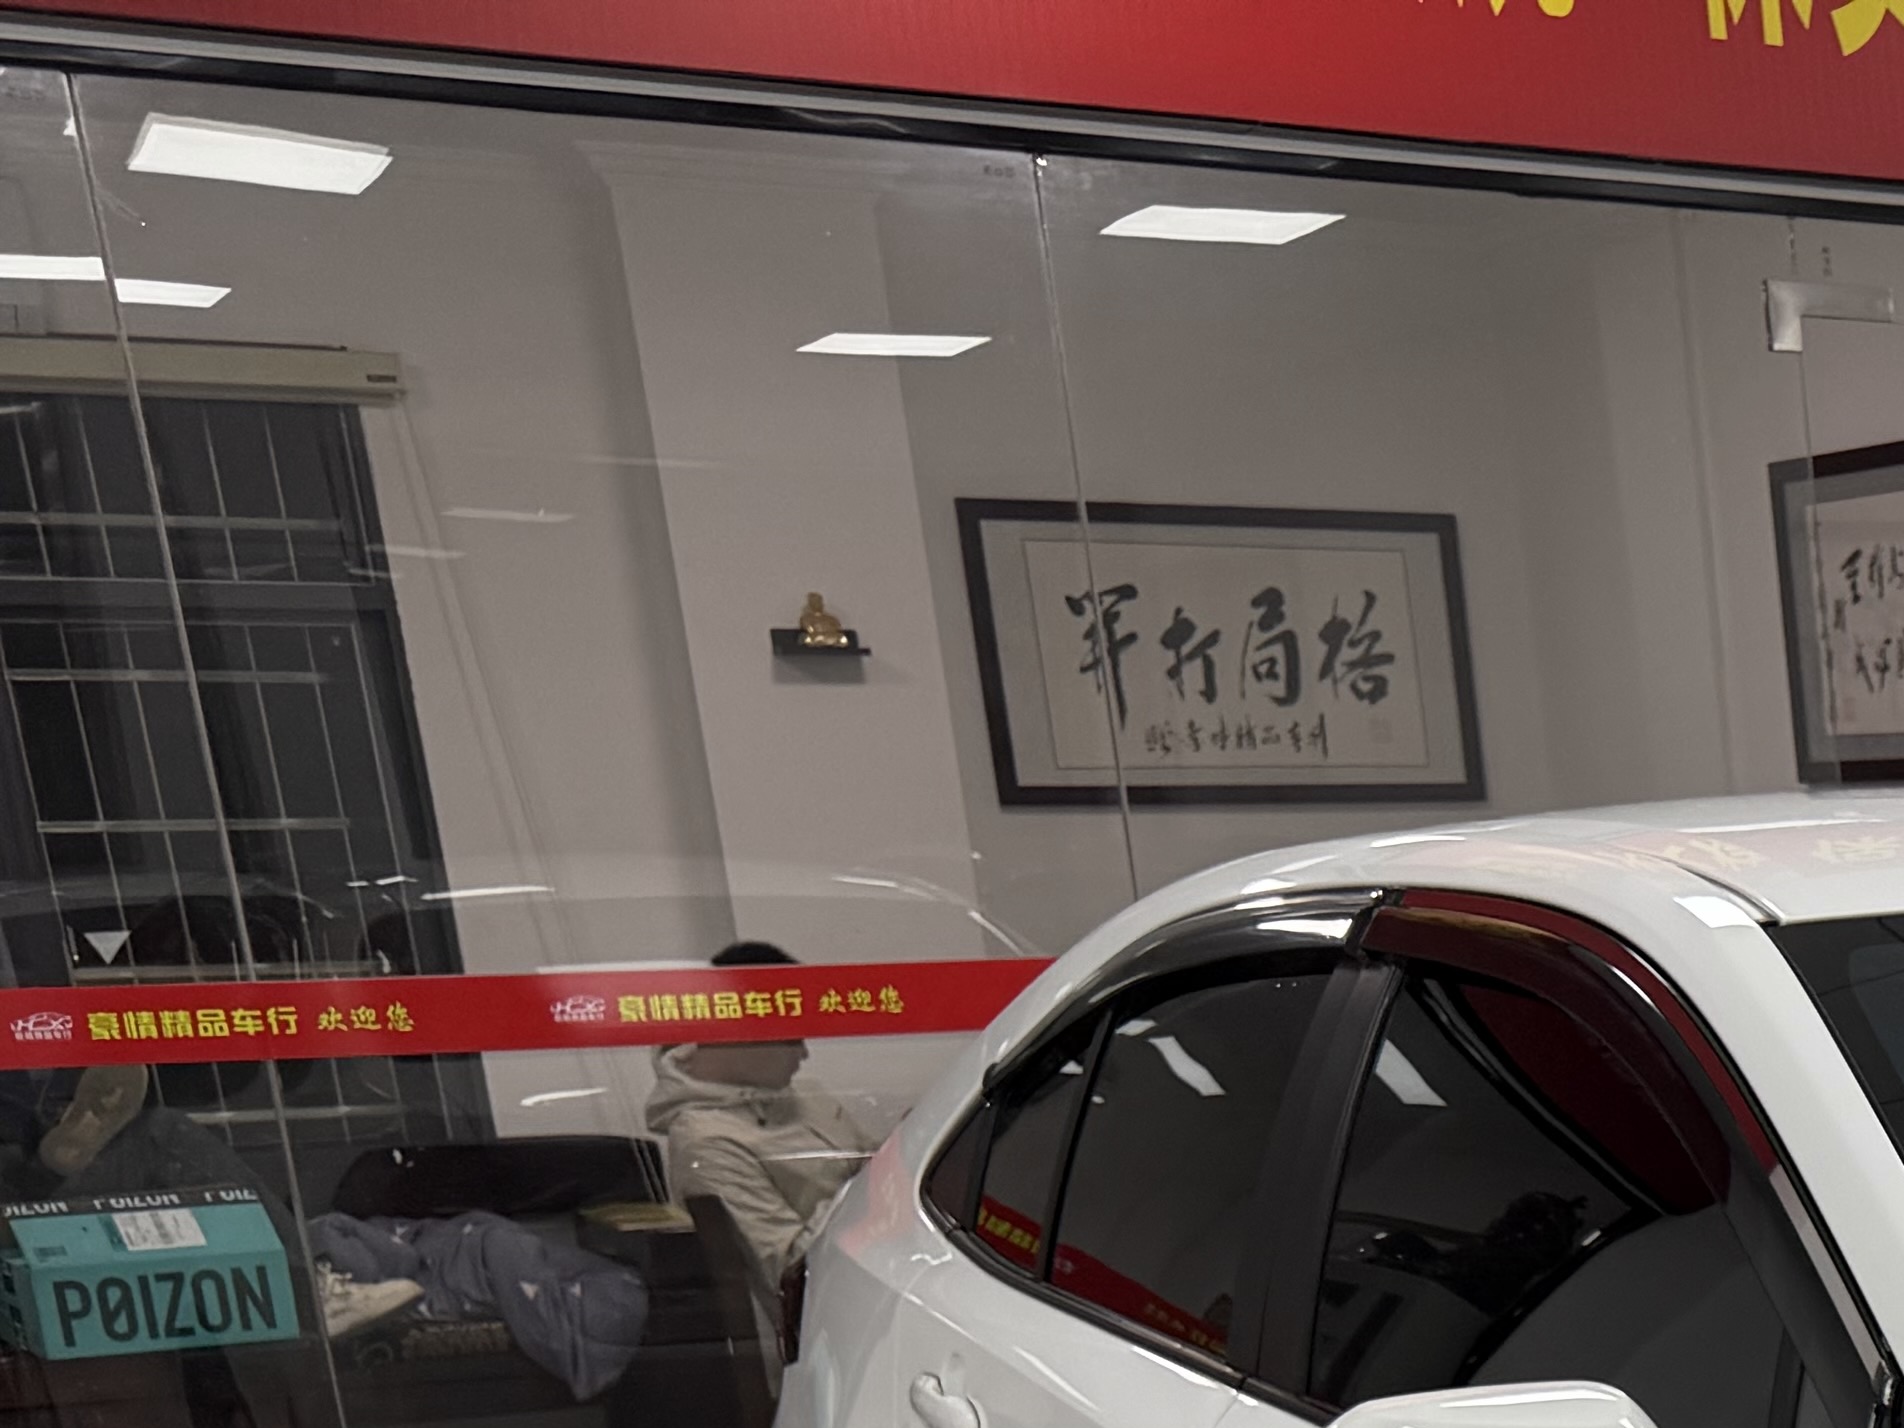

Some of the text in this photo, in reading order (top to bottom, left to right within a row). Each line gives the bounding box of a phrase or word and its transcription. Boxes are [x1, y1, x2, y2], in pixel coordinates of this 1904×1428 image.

[87, 1001, 415, 1041] 豪情精品车行 欢迎您
[618, 984, 905, 1023] 豪情精品车行 欢迎您
